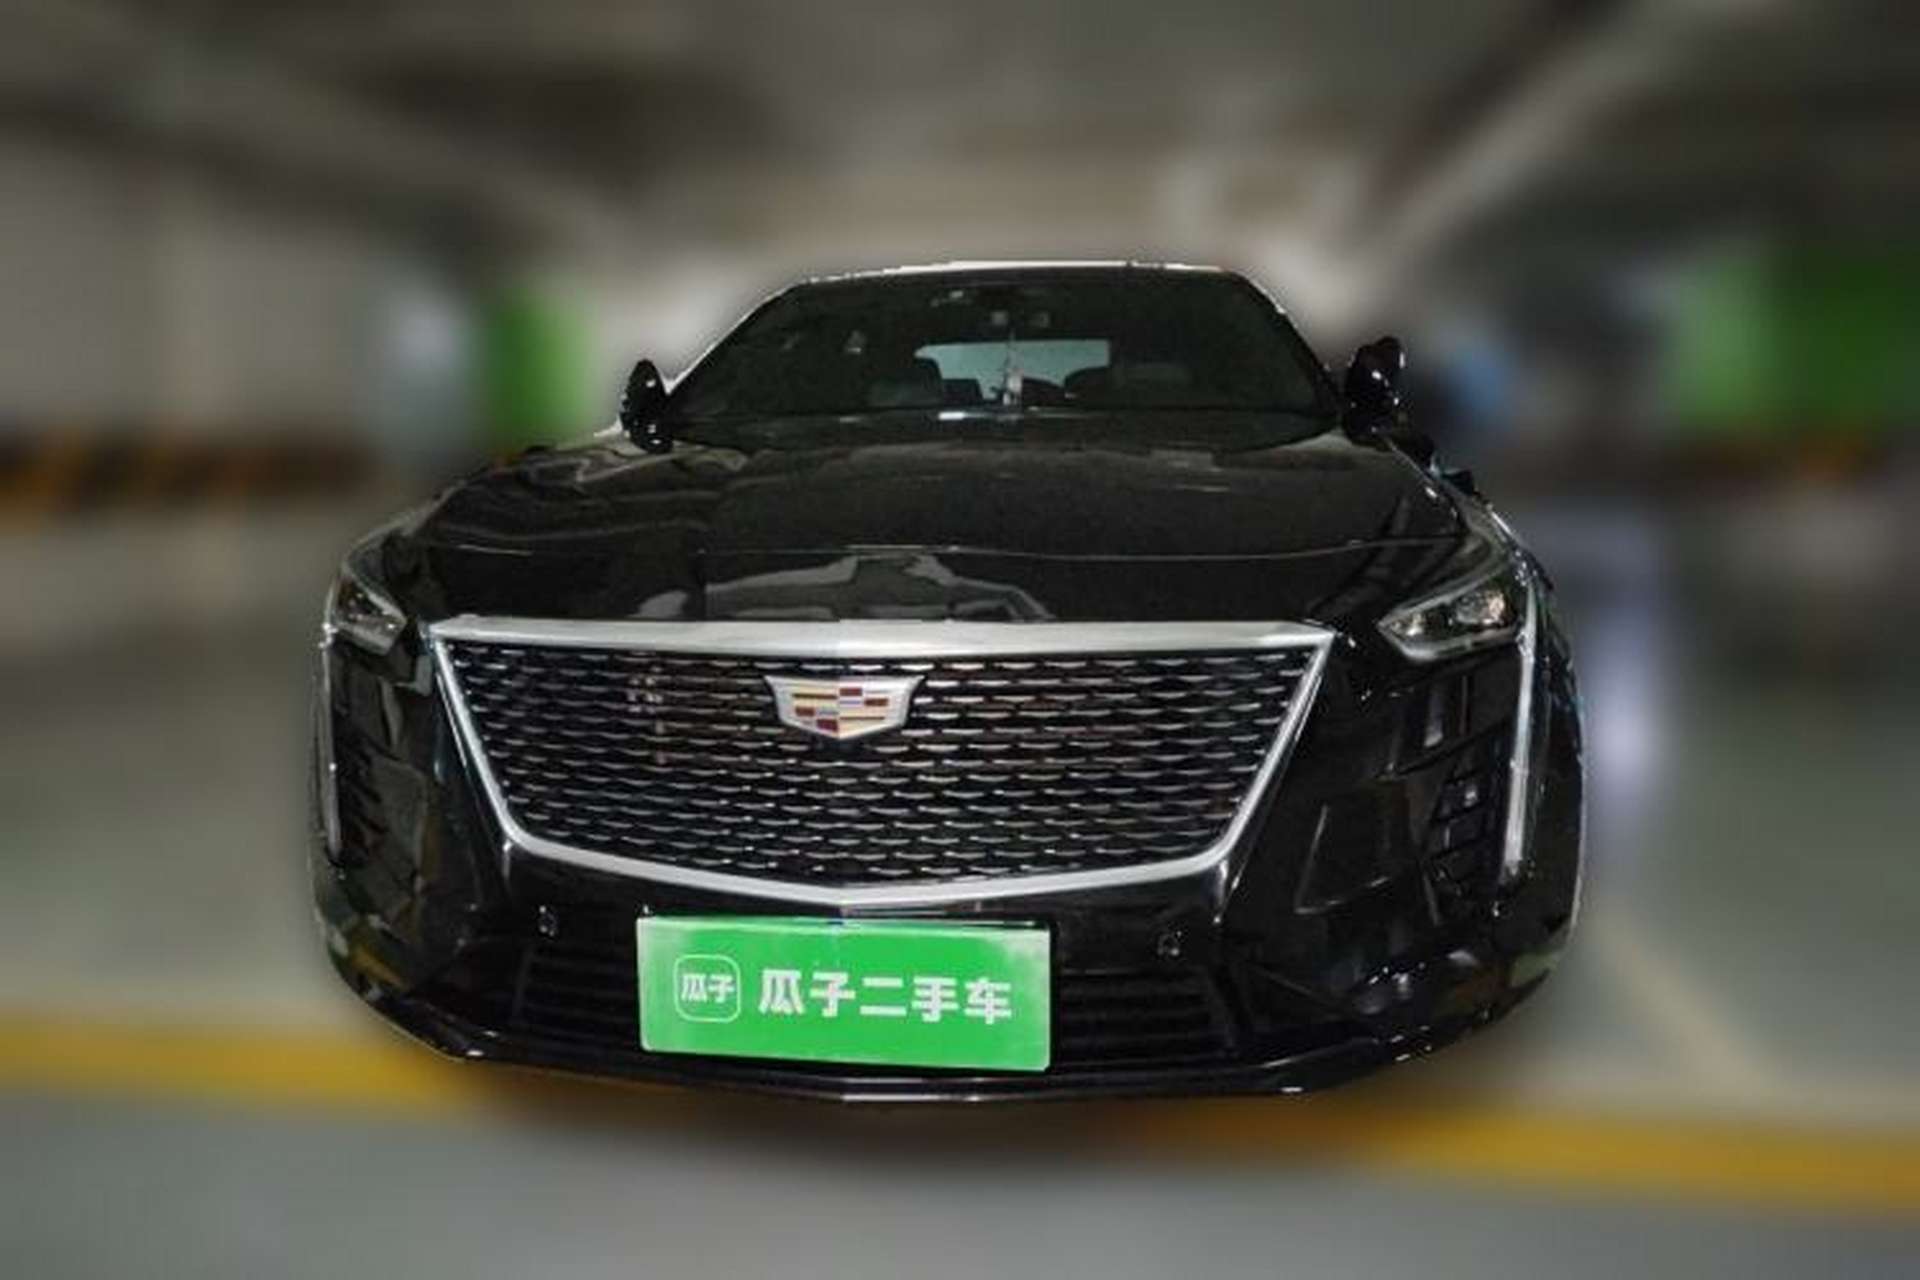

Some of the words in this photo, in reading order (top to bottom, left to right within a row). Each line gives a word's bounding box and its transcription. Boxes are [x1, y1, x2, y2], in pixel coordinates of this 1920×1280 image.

[680, 973, 735, 1003] 瓜子
[758, 968, 1013, 1025] 瓜子二手车
